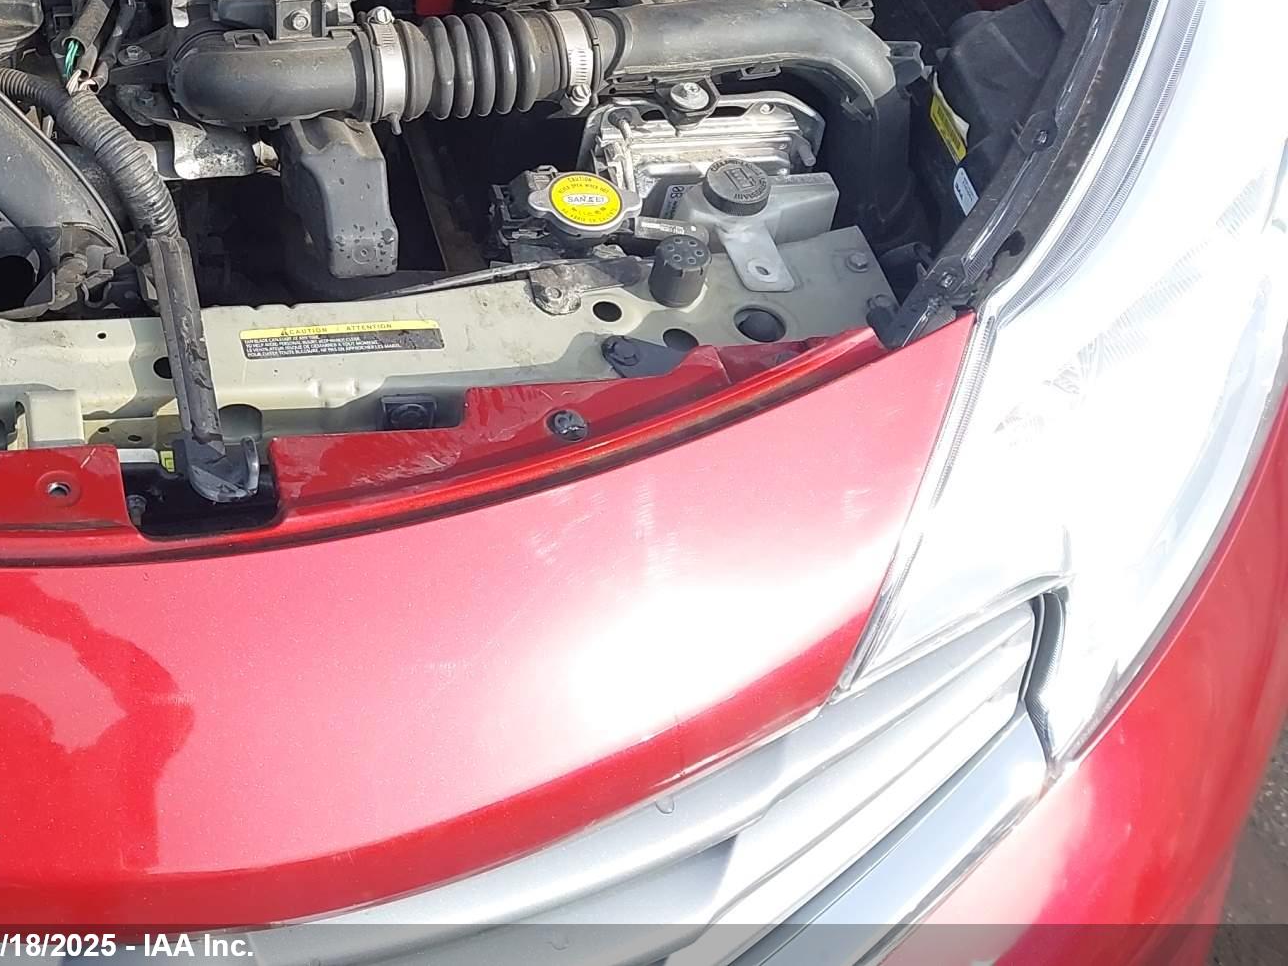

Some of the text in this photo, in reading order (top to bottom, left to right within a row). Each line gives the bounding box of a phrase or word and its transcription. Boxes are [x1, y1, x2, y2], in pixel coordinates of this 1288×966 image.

[567, 195, 605, 203] SANKEI
[289, 327, 328, 335] CAUTION
[346, 323, 392, 331] ATTENTION
